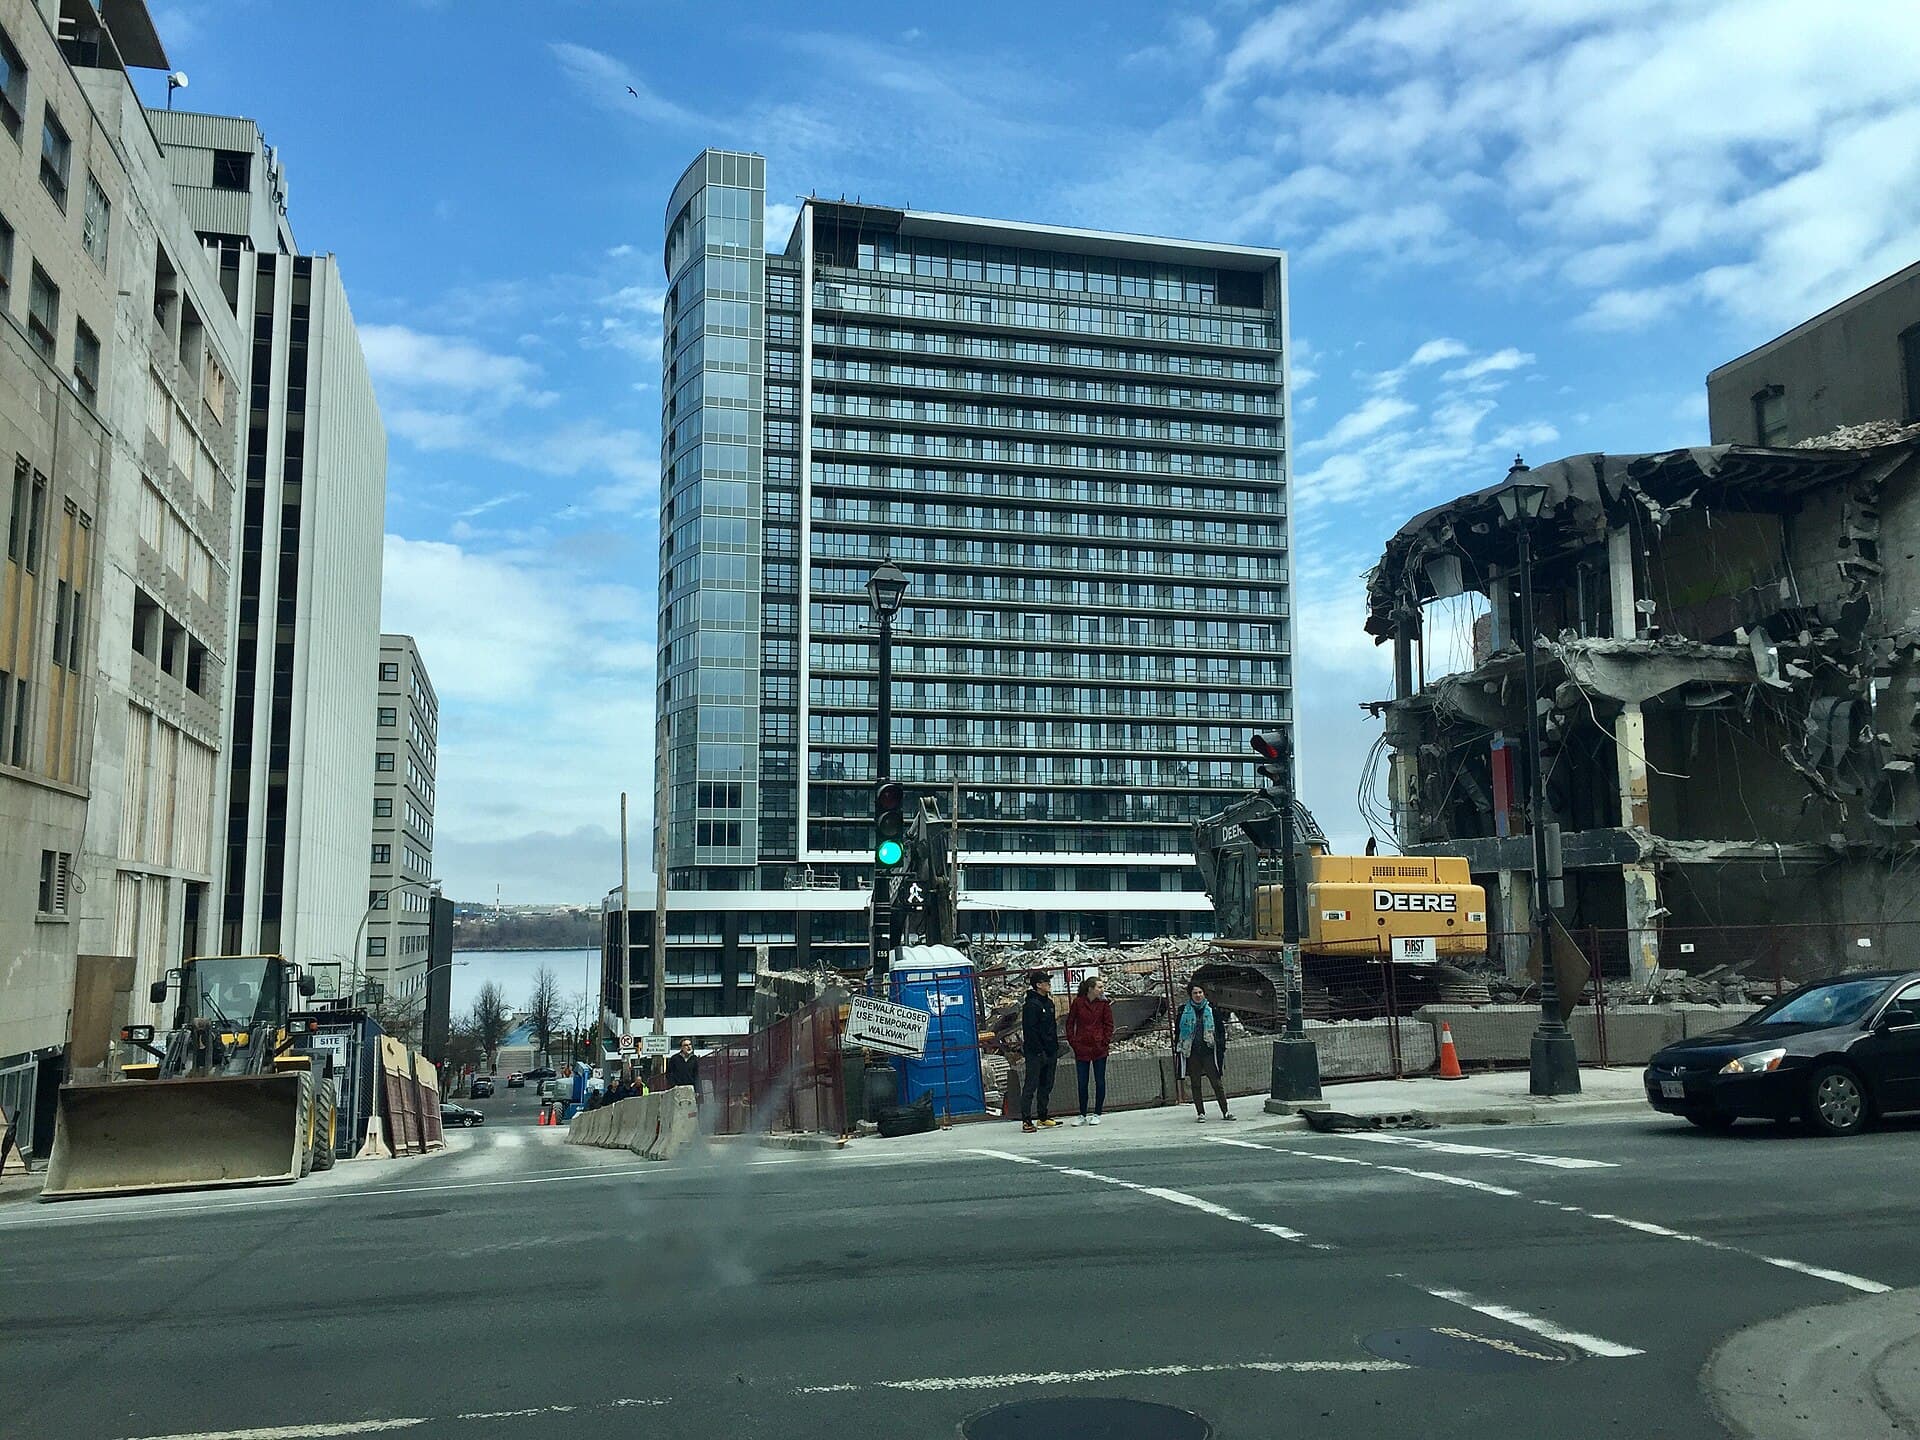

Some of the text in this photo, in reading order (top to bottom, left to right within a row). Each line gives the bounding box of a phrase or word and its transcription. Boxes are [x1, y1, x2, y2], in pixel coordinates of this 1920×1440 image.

[1222, 823, 1245, 842] DEER
[1374, 890, 1456, 912] DEERE
[1404, 939, 1425, 952] FIRST
[854, 998, 927, 1023] SIDEWALK CLOSED
[856, 1010, 922, 1033] USE TEMPORARY
[320, 1037, 340, 1046] SITE
[868, 1024, 908, 1041] WALKWAY
